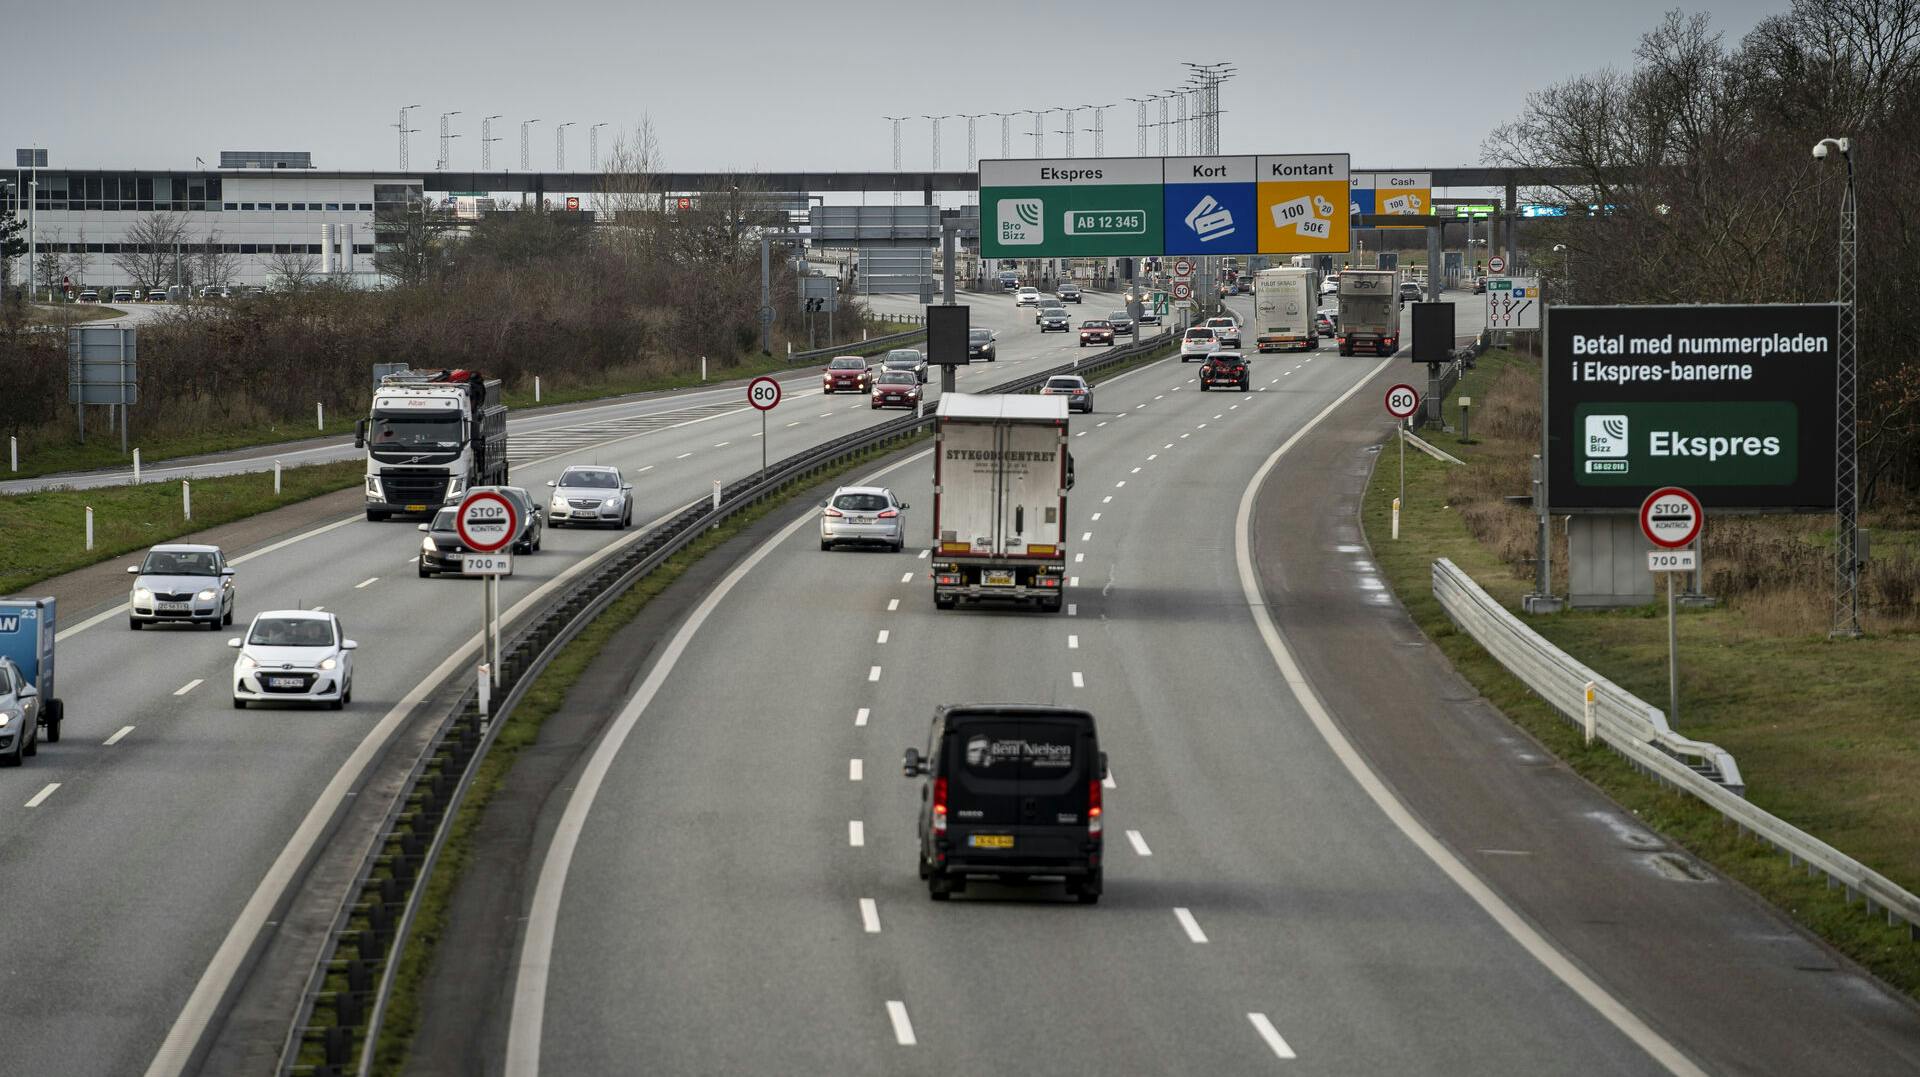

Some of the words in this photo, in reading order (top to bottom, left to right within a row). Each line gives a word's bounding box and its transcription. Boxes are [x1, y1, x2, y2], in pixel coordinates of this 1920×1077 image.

[1040, 167, 1103, 182] Ekspres
[1193, 165, 1227, 177] Kort
[1272, 163, 1334, 176] Kontant
[1390, 177, 1415, 186] Cash
[1321, 204, 1332, 214] 20
[1390, 200, 1404, 209] 100
[1281, 204, 1304, 220] 100
[1002, 222, 1021, 231] Bro
[1077, 217, 1095, 228] AB
[1100, 217, 1112, 228] 12
[1115, 216, 1138, 228] 345
[1303, 222, 1324, 233] 50€
[1002, 231, 1025, 240] Bizz
[1354, 281, 1378, 289] DSV
[1572, 334, 1624, 355] Betal
[1629, 334, 1672, 354] med
[1678, 333, 1829, 357] nummerpladen
[1572, 361, 1578, 381] i
[1583, 361, 1753, 385] Ekspres-banerne
[754, 387, 775, 400] 80
[1391, 394, 1413, 407] 80
[1590, 435, 1608, 443] Bro
[1590, 444, 1611, 452] Bizz
[1649, 431, 1781, 461] Ekspres
[470, 507, 504, 517] STOP
[1655, 504, 1689, 514] STOP
[468, 559, 493, 568] 700
[1652, 556, 1678, 566] 700
[21, 608, 37, 619] 23
[1024, 742, 1071, 755] Nielsen
